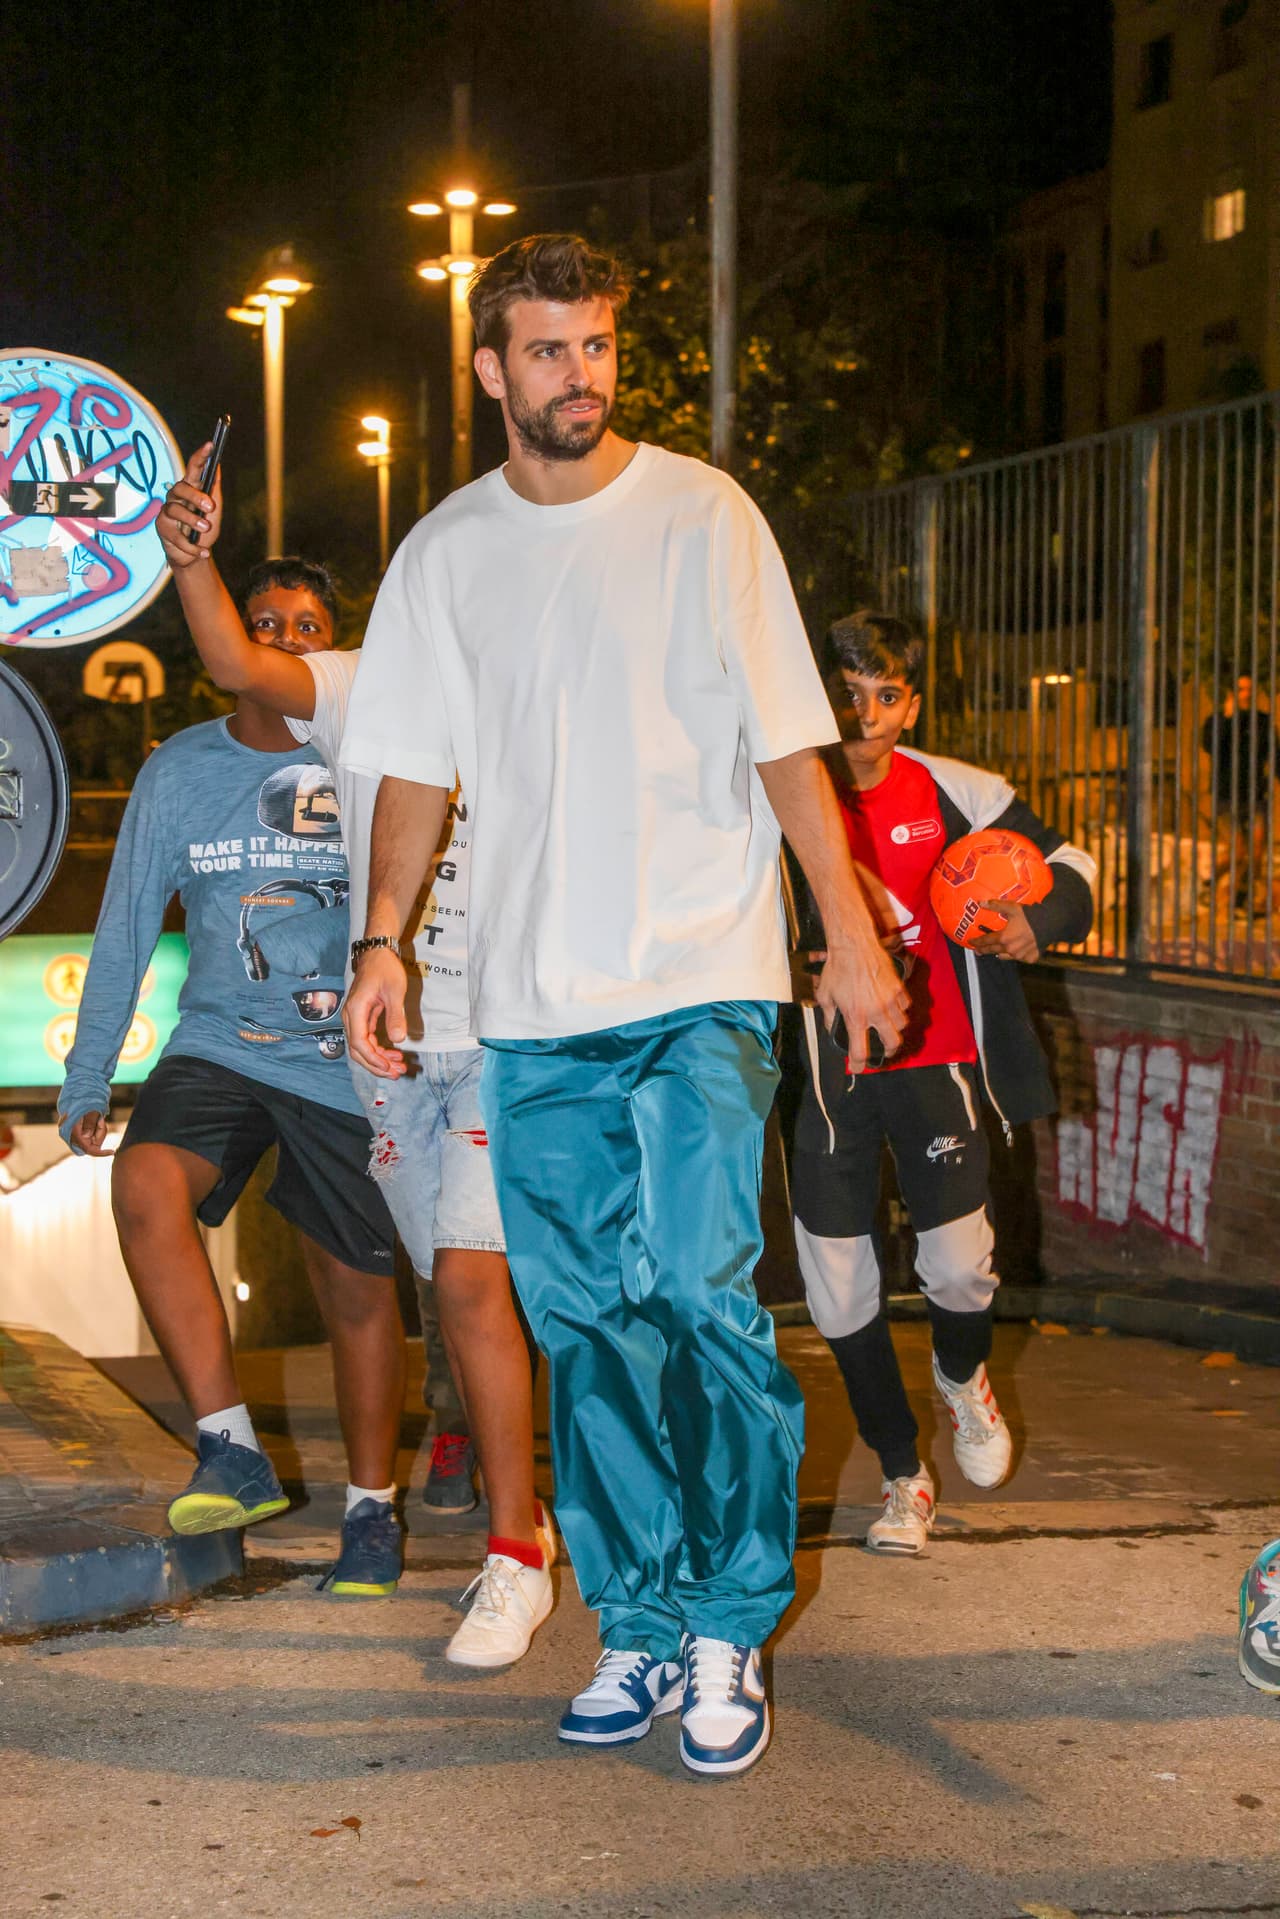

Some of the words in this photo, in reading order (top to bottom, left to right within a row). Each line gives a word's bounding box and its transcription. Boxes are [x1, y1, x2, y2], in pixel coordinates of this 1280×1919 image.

[189, 839, 243, 858] MAKE
[250, 836, 268, 851] IT
[190, 856, 241, 874] YOUR
[248, 854, 293, 868] TIME
[435, 860, 457, 882] G
[431, 905, 452, 915] SEE
[455, 909, 466, 917] IN
[423, 924, 444, 946] T
[424, 963, 462, 977] WORLD
[932, 1136, 959, 1149] NIKE
